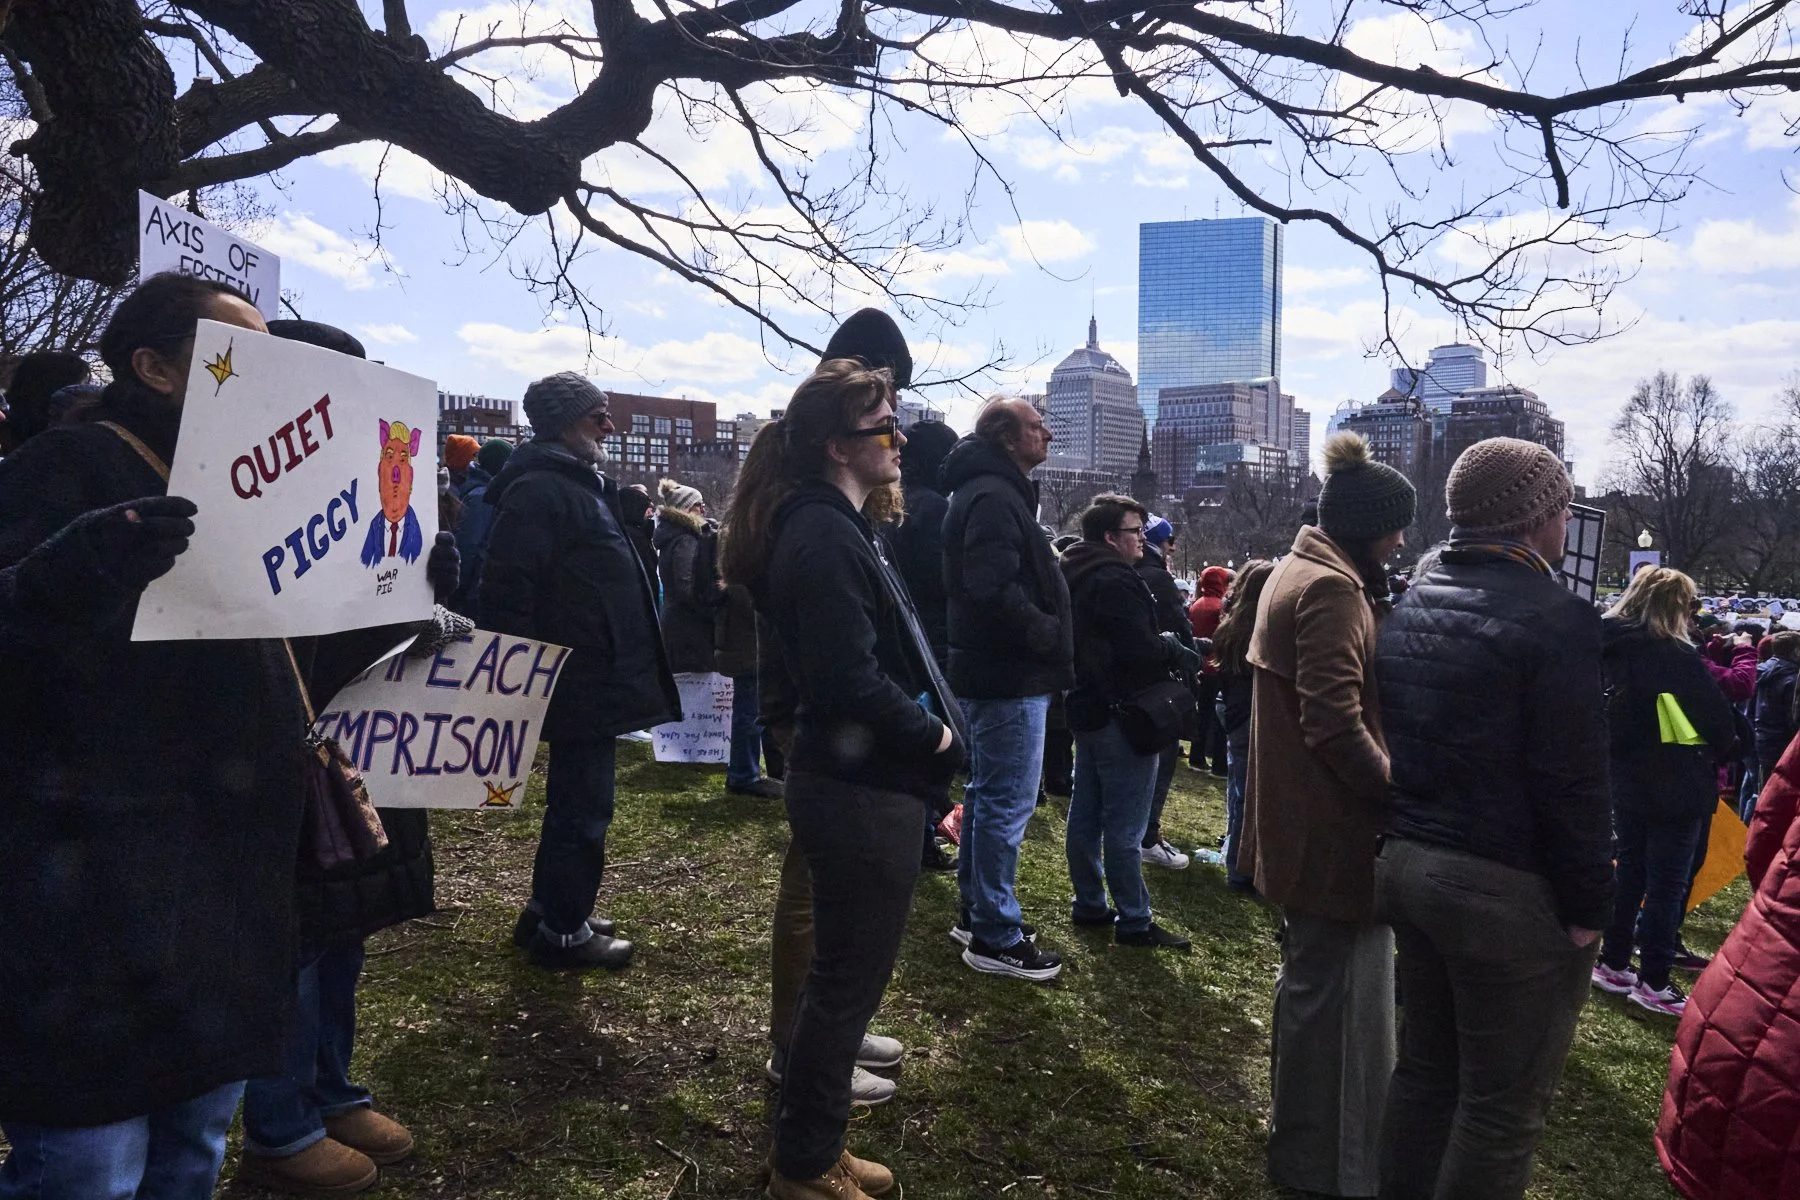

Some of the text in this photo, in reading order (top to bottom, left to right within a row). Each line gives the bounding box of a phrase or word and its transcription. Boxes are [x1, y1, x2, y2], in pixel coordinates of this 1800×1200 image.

[145, 205, 260, 278] AXIS OF
[230, 393, 334, 499] QUIET
[261, 477, 359, 596] PIGGY
[376, 568, 399, 583] WAR
[376, 581, 393, 596] PIG
[345, 632, 571, 699] EACH
[998, 953, 1024, 968] HOKA
